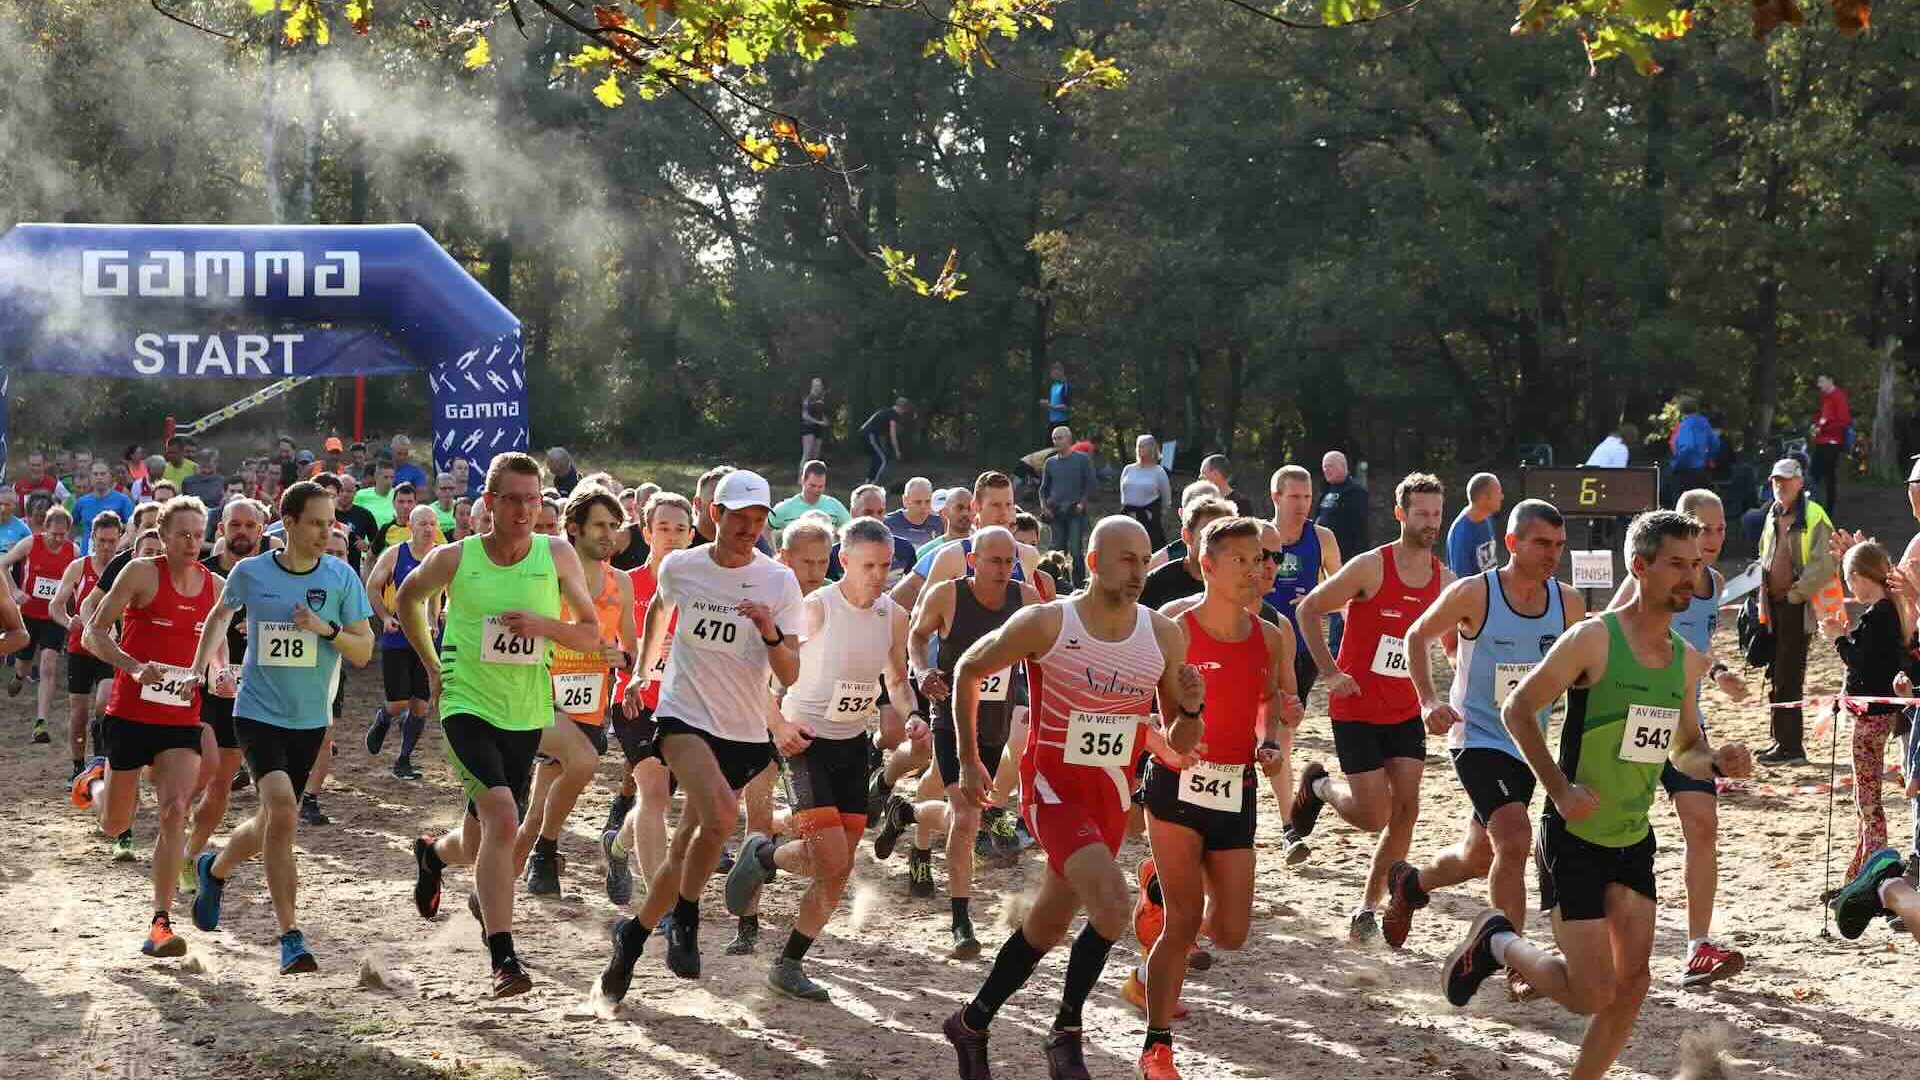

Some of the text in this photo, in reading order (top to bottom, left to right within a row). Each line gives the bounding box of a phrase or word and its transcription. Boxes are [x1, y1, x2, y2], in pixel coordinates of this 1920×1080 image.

[133, 333, 304, 375] START
[1575, 566, 1610, 580] FINISH
[693, 618, 737, 643] 470
[270, 638, 304, 658] 218
[493, 633, 534, 655] 460
[563, 688, 592, 706] 265
[837, 697, 873, 712] 532
[1080, 731, 1124, 756] 356
[1634, 726, 1672, 750] 543
[1190, 773, 1232, 799] 541
